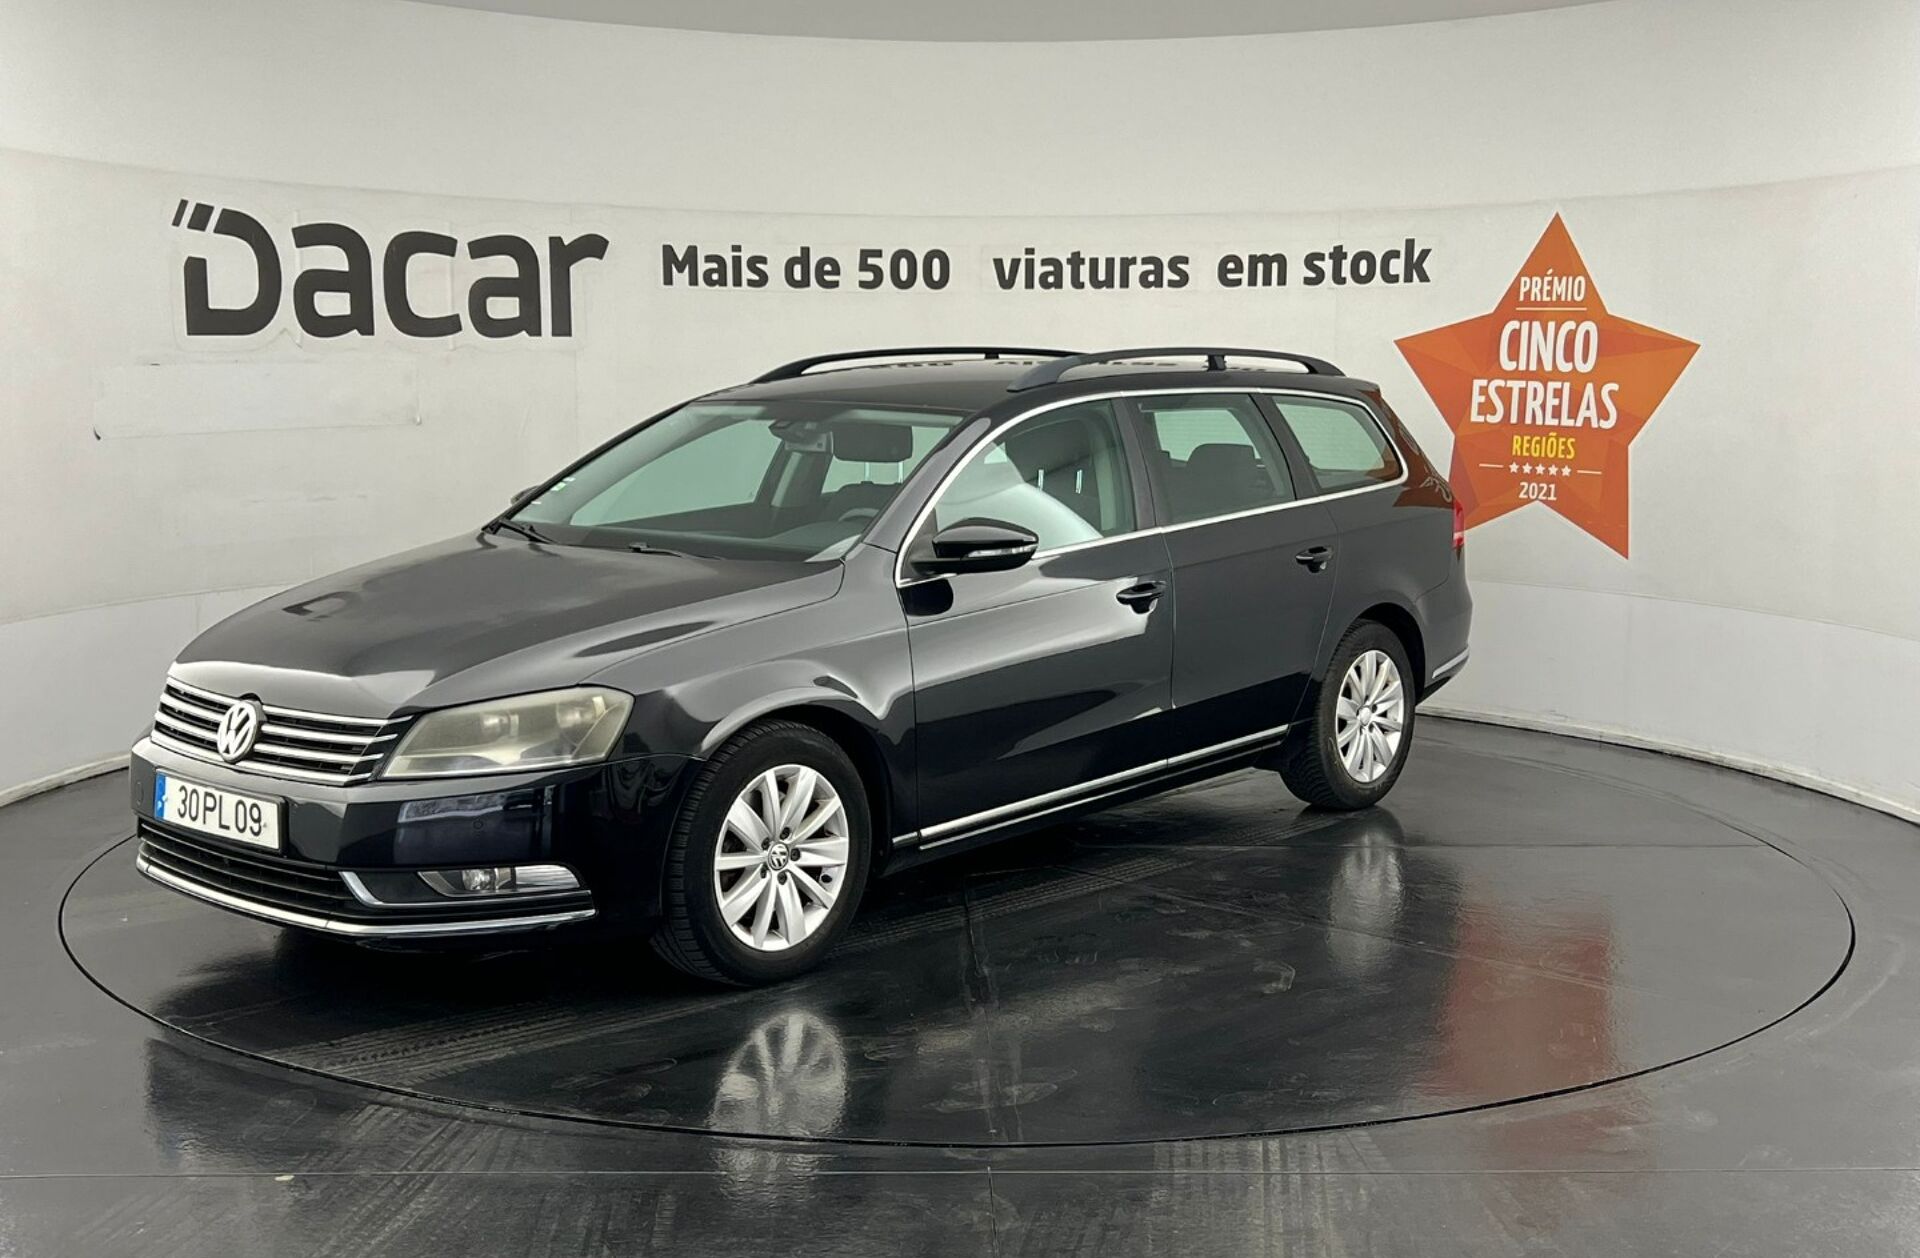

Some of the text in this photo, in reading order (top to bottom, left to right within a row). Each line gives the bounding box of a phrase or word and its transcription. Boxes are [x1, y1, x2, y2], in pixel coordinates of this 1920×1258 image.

[172, 199, 609, 338] Dacar
[662, 237, 1433, 290] Mais de 500 viaturas em stock
[1519, 268, 1586, 302] PRÉMIO
[1499, 320, 1598, 373] CINCO
[1470, 379, 1620, 430] ESTRELAS
[1512, 432, 1576, 460] REGIÕES
[1518, 481, 1557, 501] 2021
